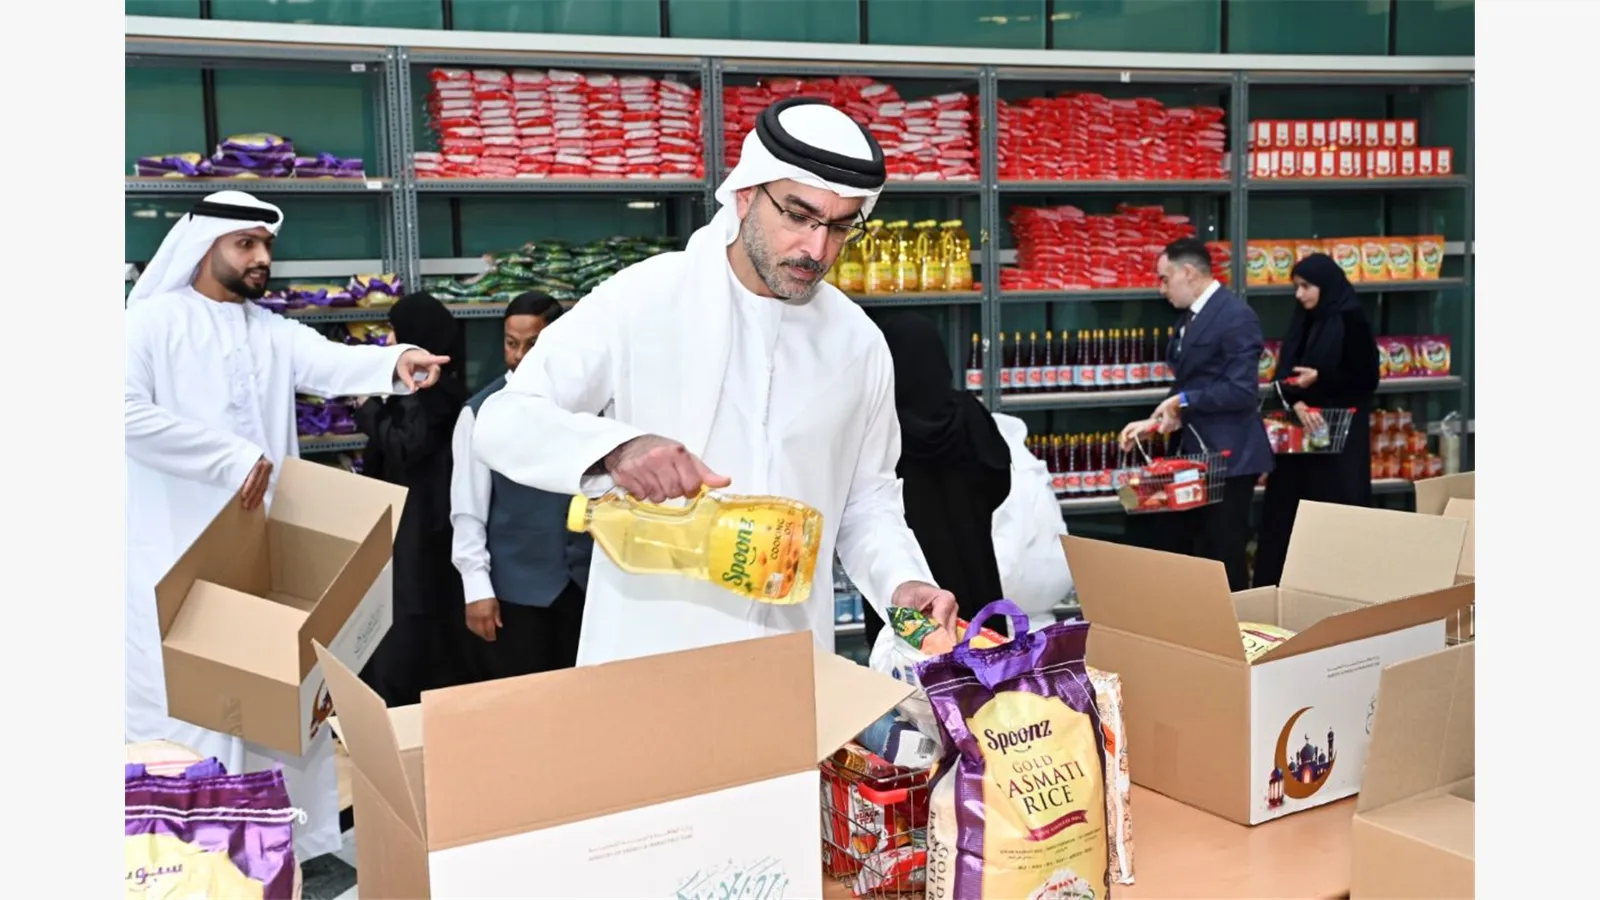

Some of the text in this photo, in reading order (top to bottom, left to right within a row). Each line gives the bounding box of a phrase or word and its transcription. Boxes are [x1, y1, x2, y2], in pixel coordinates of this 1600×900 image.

[721, 517, 756, 587] Spoonz
[770, 518, 785, 560] COOKING
[984, 719, 1053, 755] Spoonz
[996, 760, 1085, 799] ASMATI
[1012, 755, 1054, 774] GOLD
[1023, 784, 1075, 815] RICE
